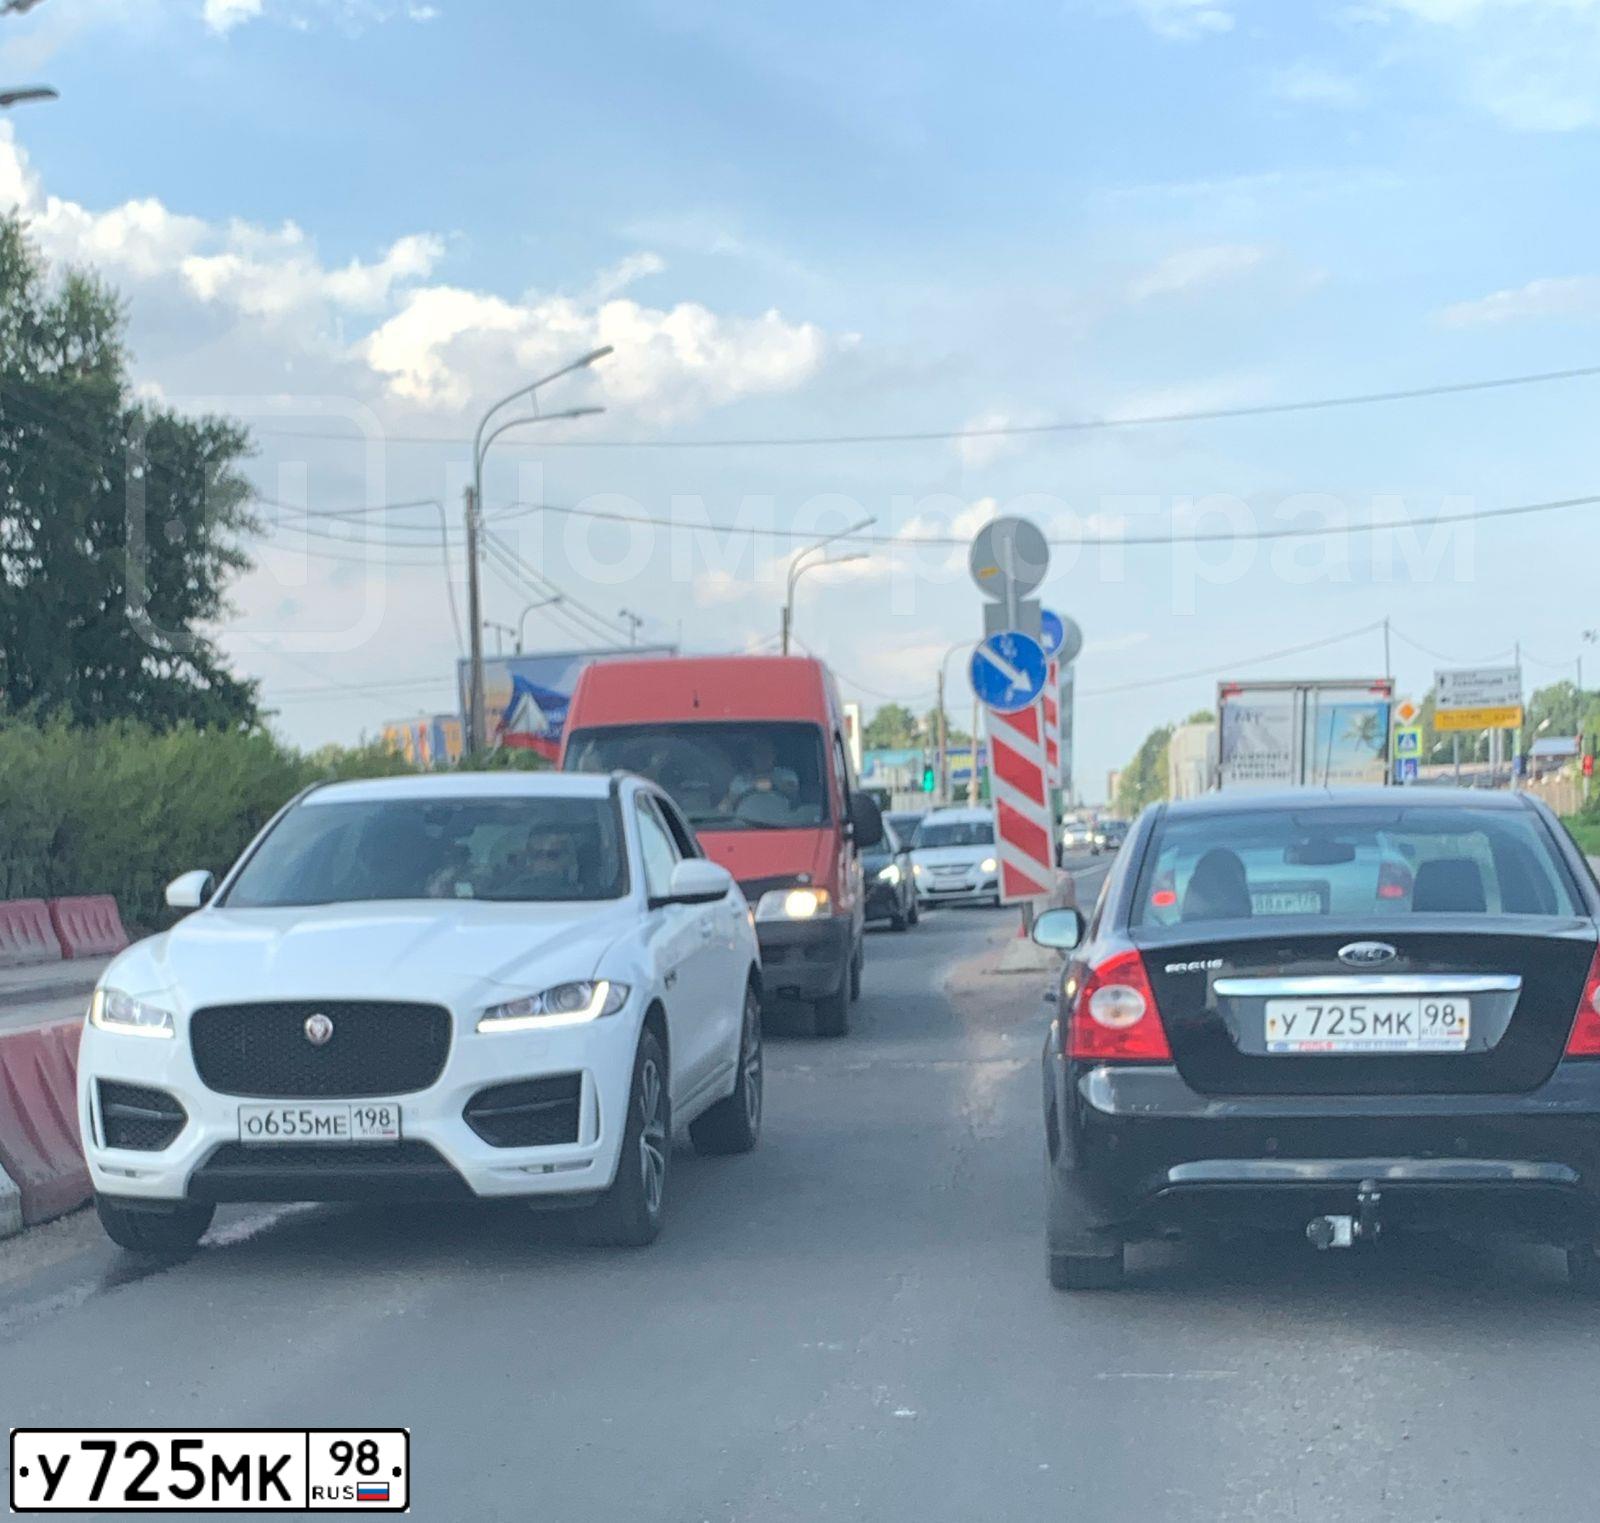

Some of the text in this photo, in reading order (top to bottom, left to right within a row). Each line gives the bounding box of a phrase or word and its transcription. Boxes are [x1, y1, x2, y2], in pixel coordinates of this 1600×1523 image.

[1424, 1003, 1456, 1028] 98
[247, 1107, 391, 1135] О655МЕ 198
